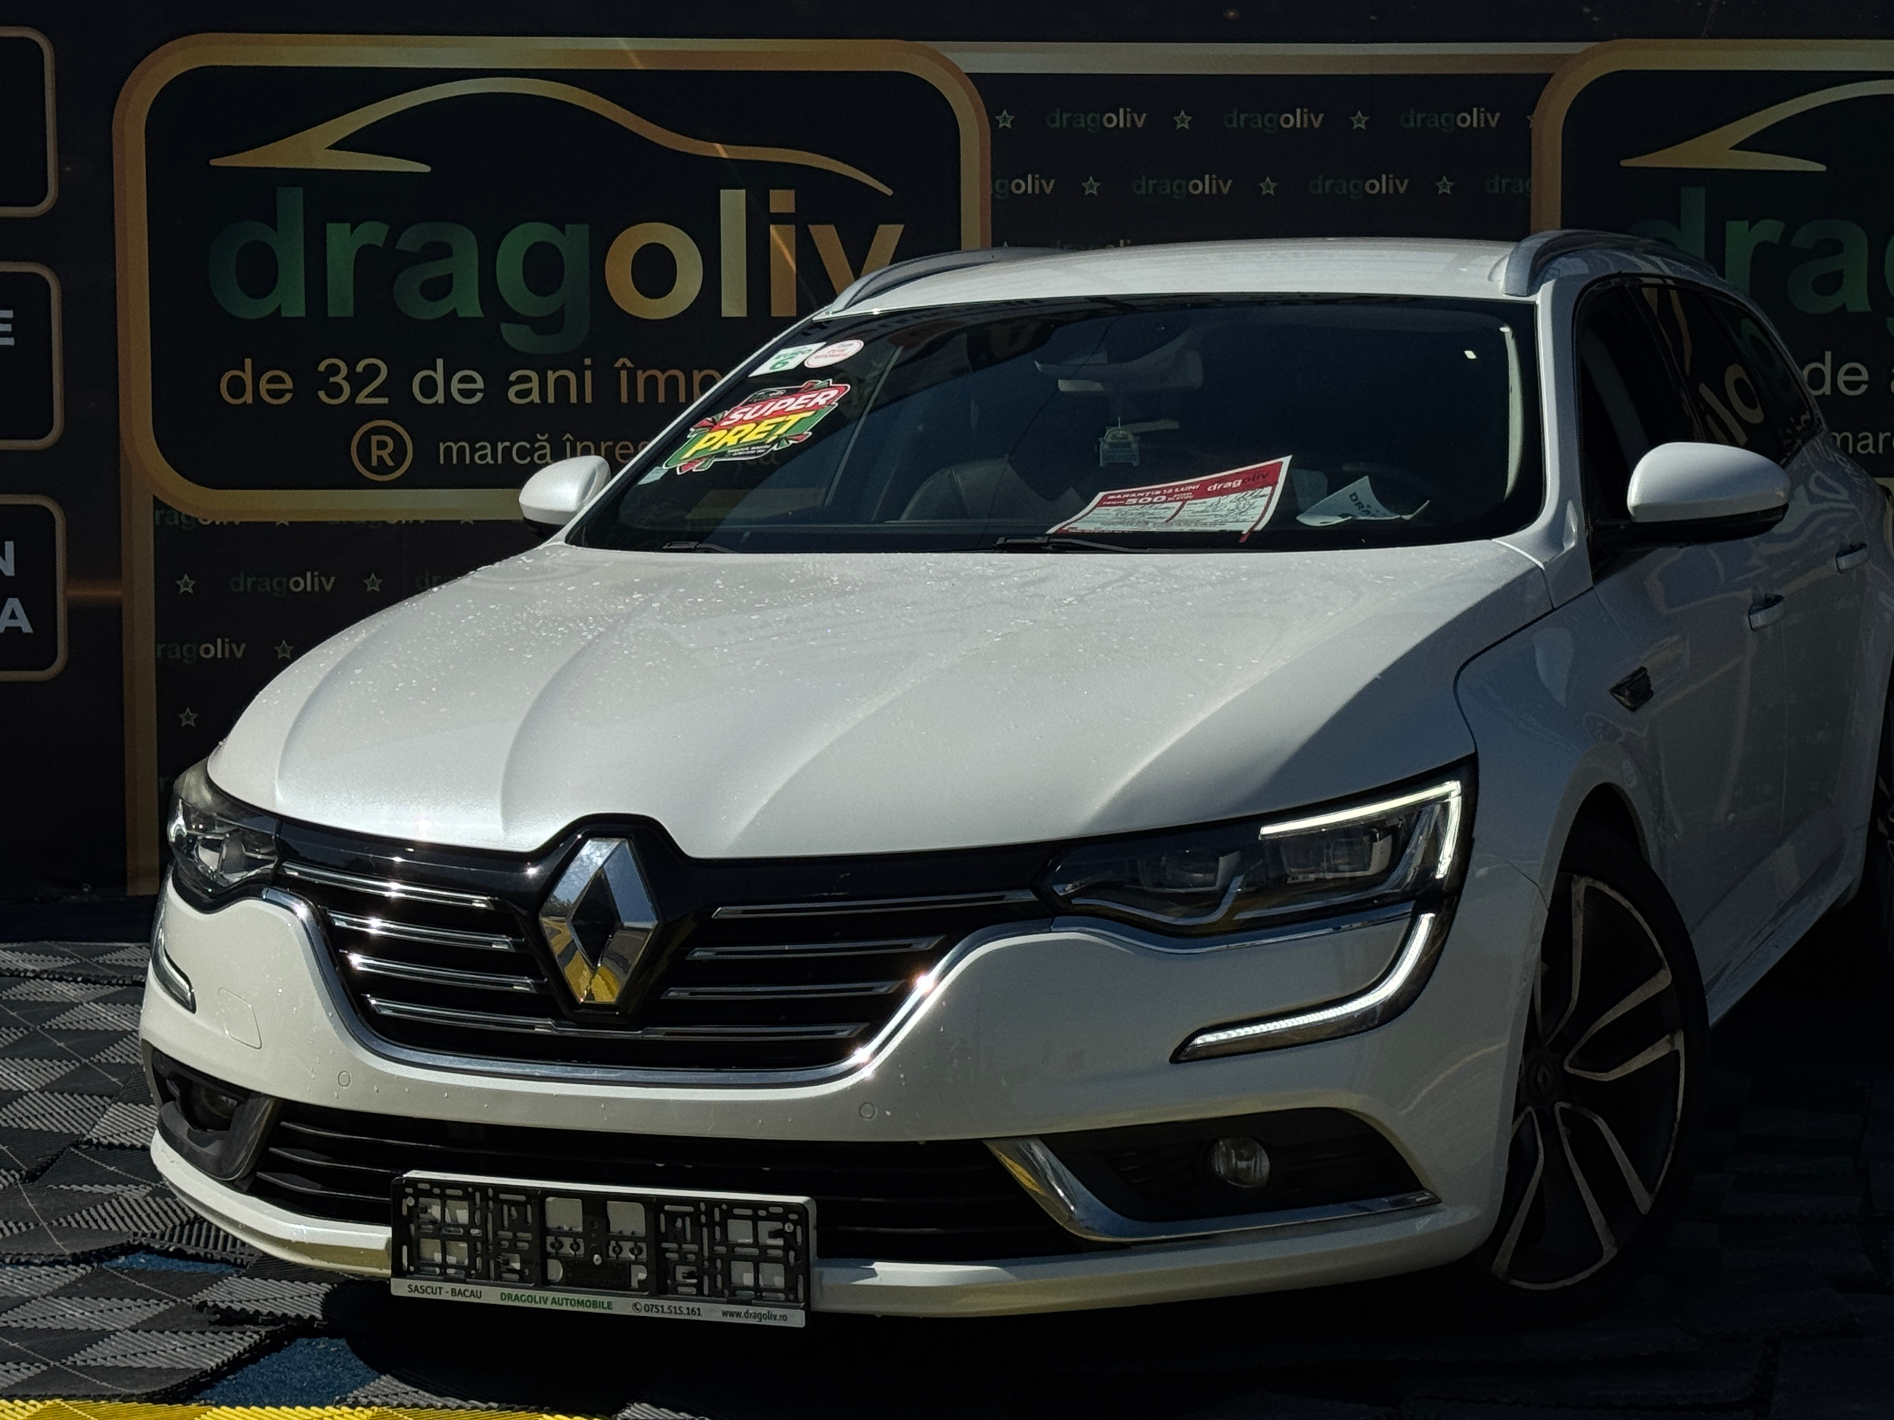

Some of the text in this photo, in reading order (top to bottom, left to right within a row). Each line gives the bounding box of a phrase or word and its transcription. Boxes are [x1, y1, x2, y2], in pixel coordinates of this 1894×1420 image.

[1046, 107, 1501, 133] dragoliv dragoliv dragoliv
[1132, 173, 1233, 200] dragoliv
[1308, 173, 1410, 200] dragoliv
[208, 186, 905, 355] dragoliv
[220, 357, 293, 406] de
[316, 357, 390, 406] 32
[411, 357, 485, 406] de
[507, 357, 593, 406] ani
[1802, 350, 1869, 397] de
[720, 388, 839, 427] SUPER
[439, 433, 553, 466] marcă
[1207, 472, 1269, 492] dragoliv
[1124, 495, 1167, 505] 500
[229, 571, 336, 598] dragoliv
[407, 1284, 443, 1296] SASCUT
[451, 1287, 483, 1300] BACAU
[500, 1292, 613, 1311] DRAGOLIV AUTOMOBILE
[643, 1303, 702, 1317] 0751.515.161
[721, 1308, 788, 1323] www.dragoliv.ro
